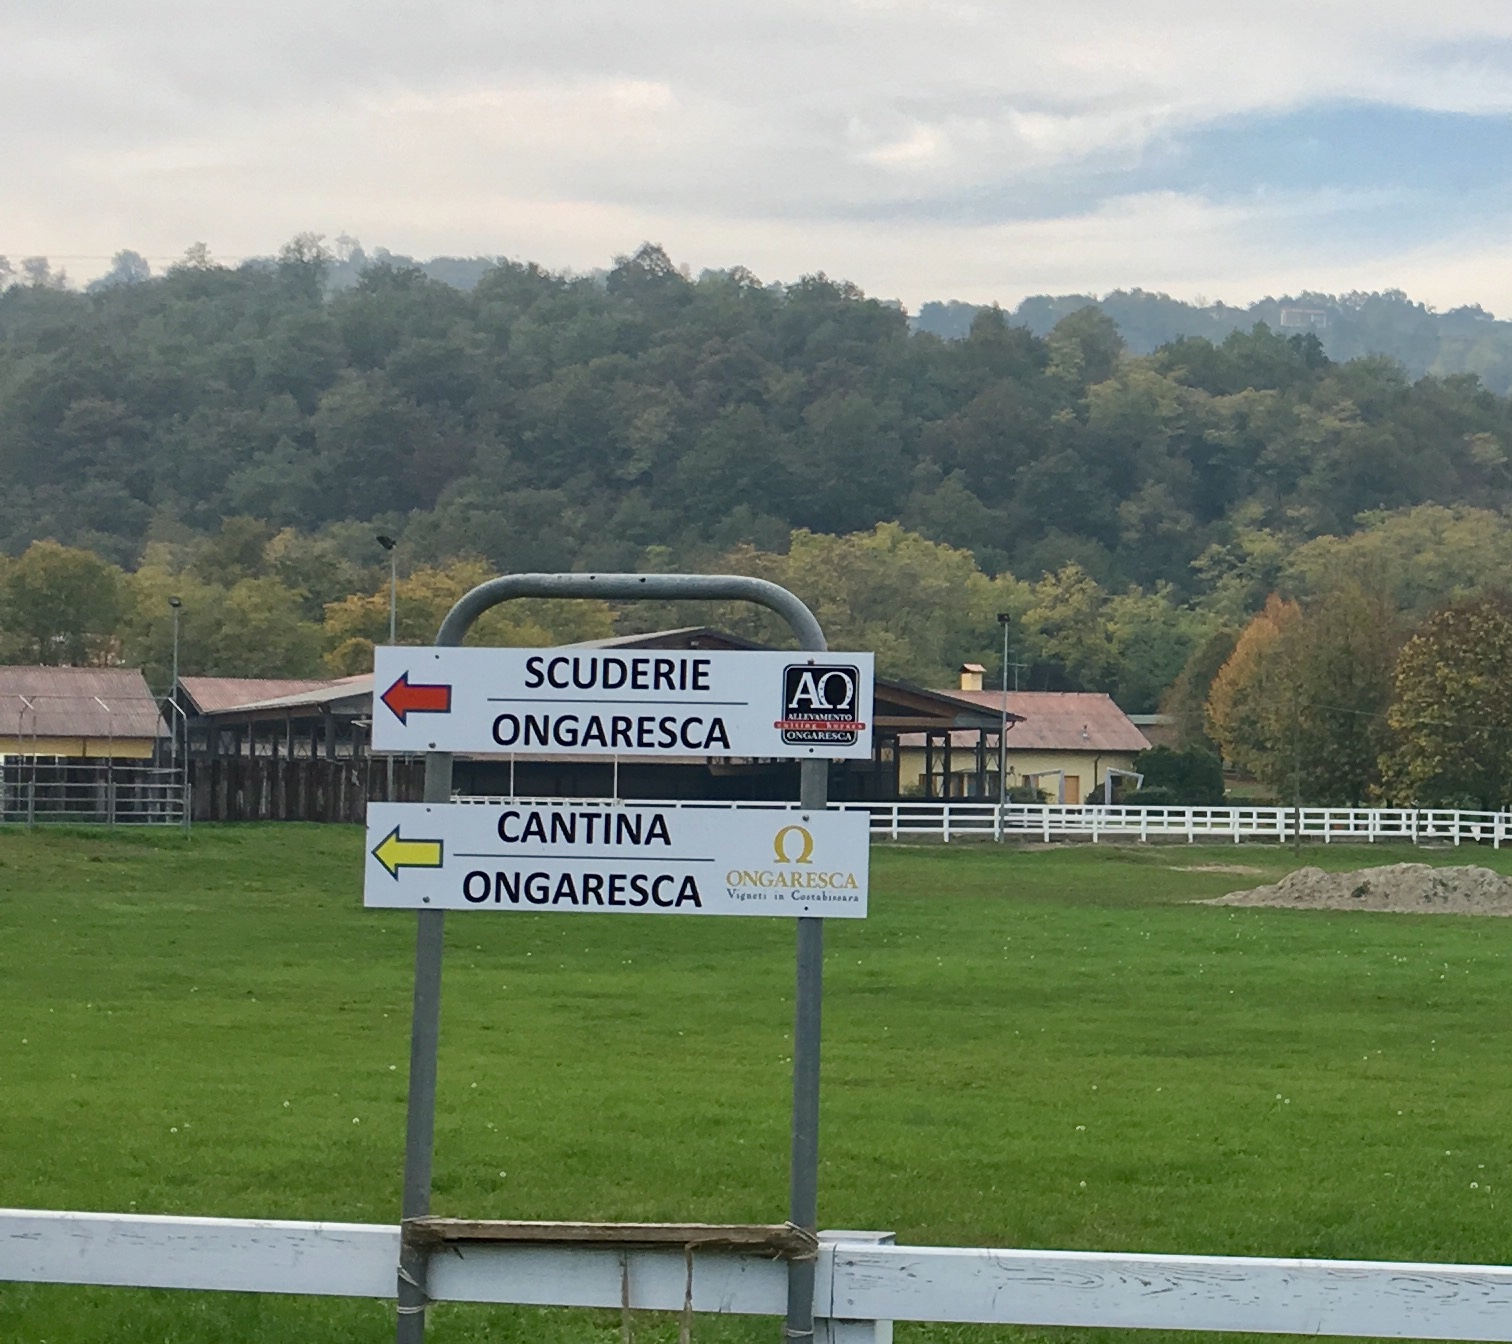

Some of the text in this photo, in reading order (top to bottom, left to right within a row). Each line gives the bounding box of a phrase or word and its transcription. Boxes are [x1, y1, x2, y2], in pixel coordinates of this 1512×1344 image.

[524, 656, 711, 691] SCUDERIE
[787, 712, 853, 722] ALLEVAMENTO
[492, 713, 731, 750] ONGARESCA
[786, 730, 852, 741] ONGARESCA
[497, 810, 672, 846] CANTINA
[462, 870, 703, 908] ONGARESCA
[726, 869, 859, 889] ONGARESCA
[726, 888, 859, 902] Vigneti in Costabissara
